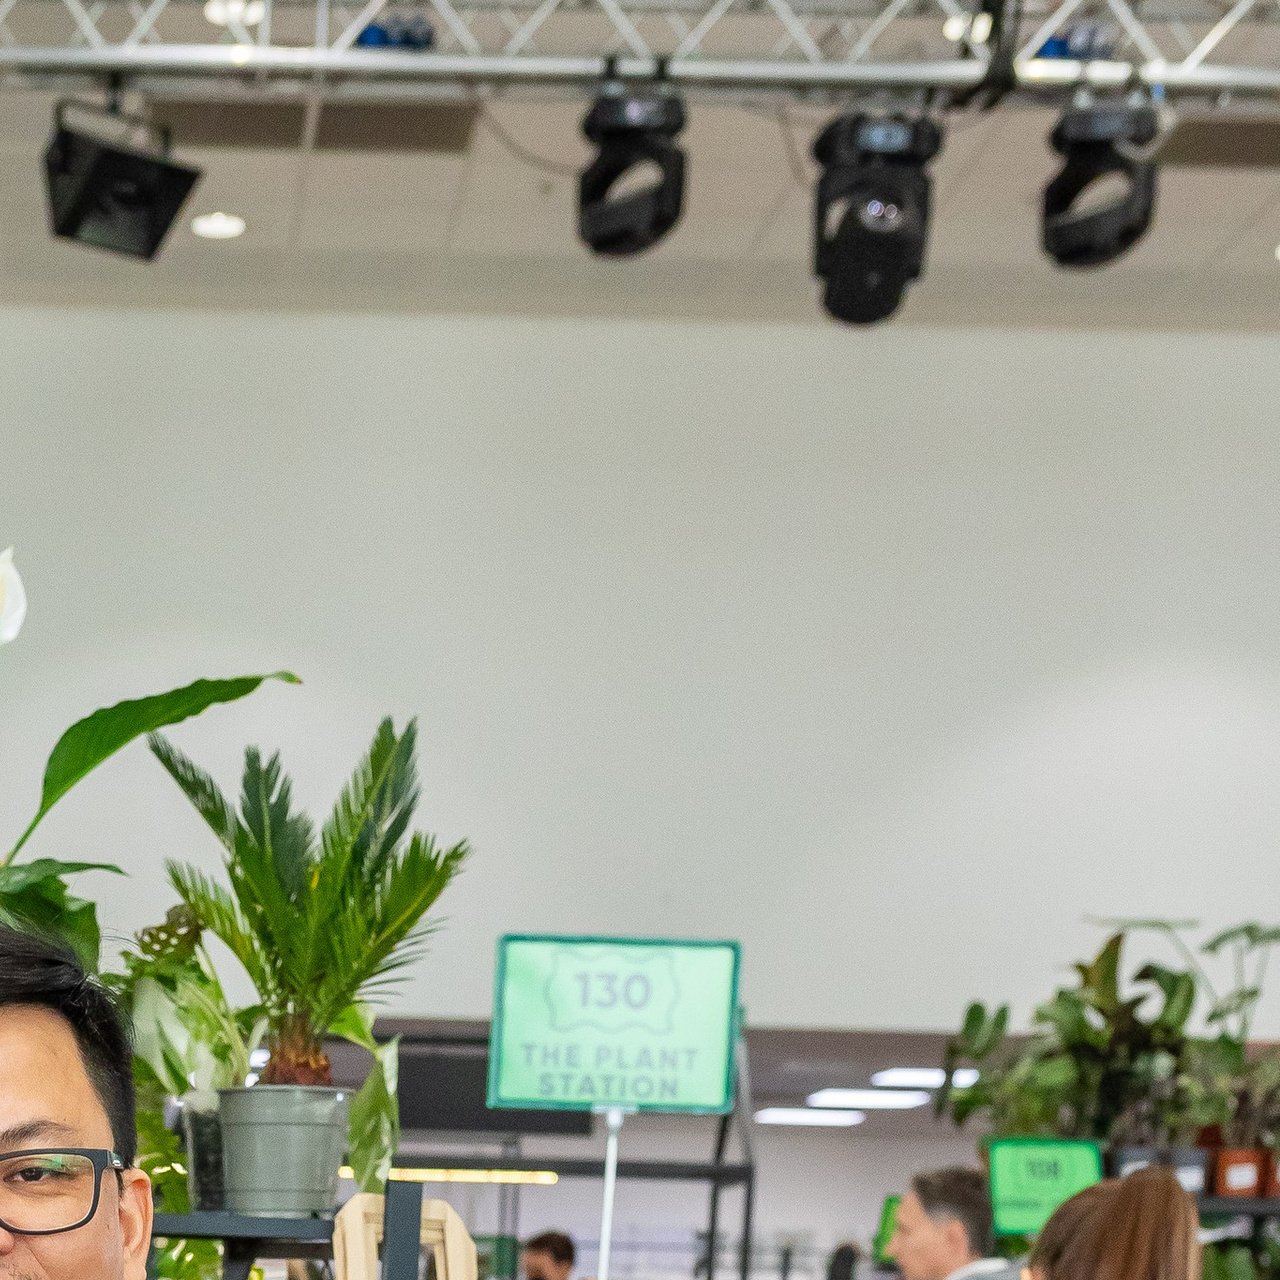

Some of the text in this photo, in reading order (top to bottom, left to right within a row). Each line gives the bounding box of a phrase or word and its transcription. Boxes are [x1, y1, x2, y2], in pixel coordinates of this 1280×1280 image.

[574, 971, 651, 1010] 130
[521, 1042, 699, 1071] THE PLANT
[538, 1072, 679, 1099] STATION
